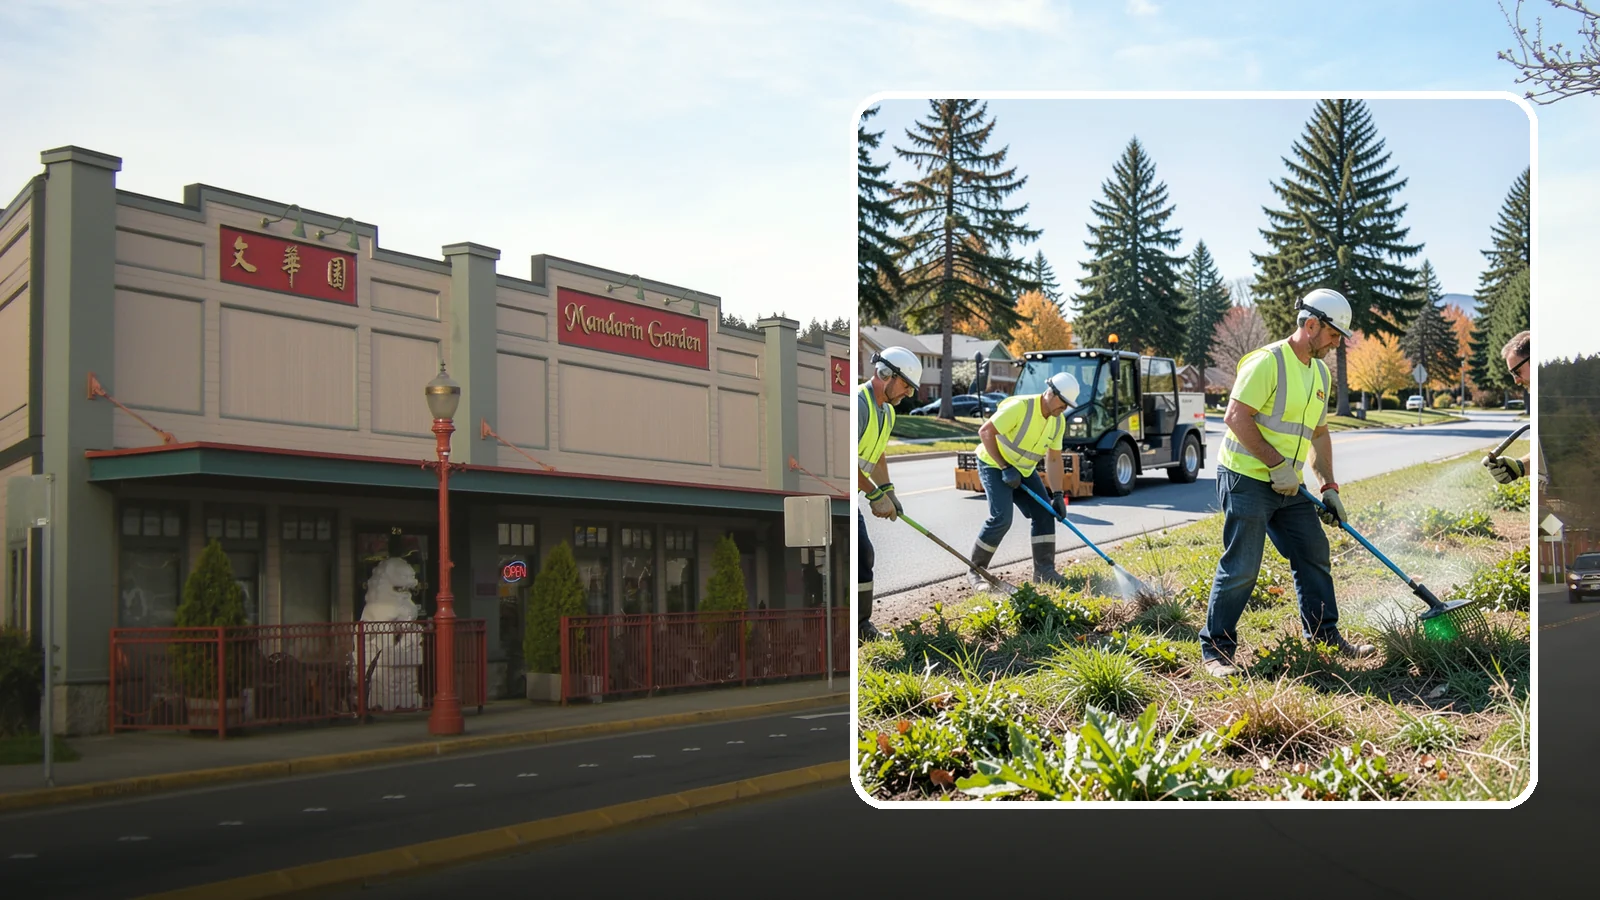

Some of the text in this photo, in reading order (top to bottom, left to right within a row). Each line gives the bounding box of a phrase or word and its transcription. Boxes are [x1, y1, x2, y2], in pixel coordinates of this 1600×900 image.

[230, 235, 346, 290] 文華園
[564, 302, 701, 352] Mandarin Garden
[503, 565, 527, 578] OPEN
